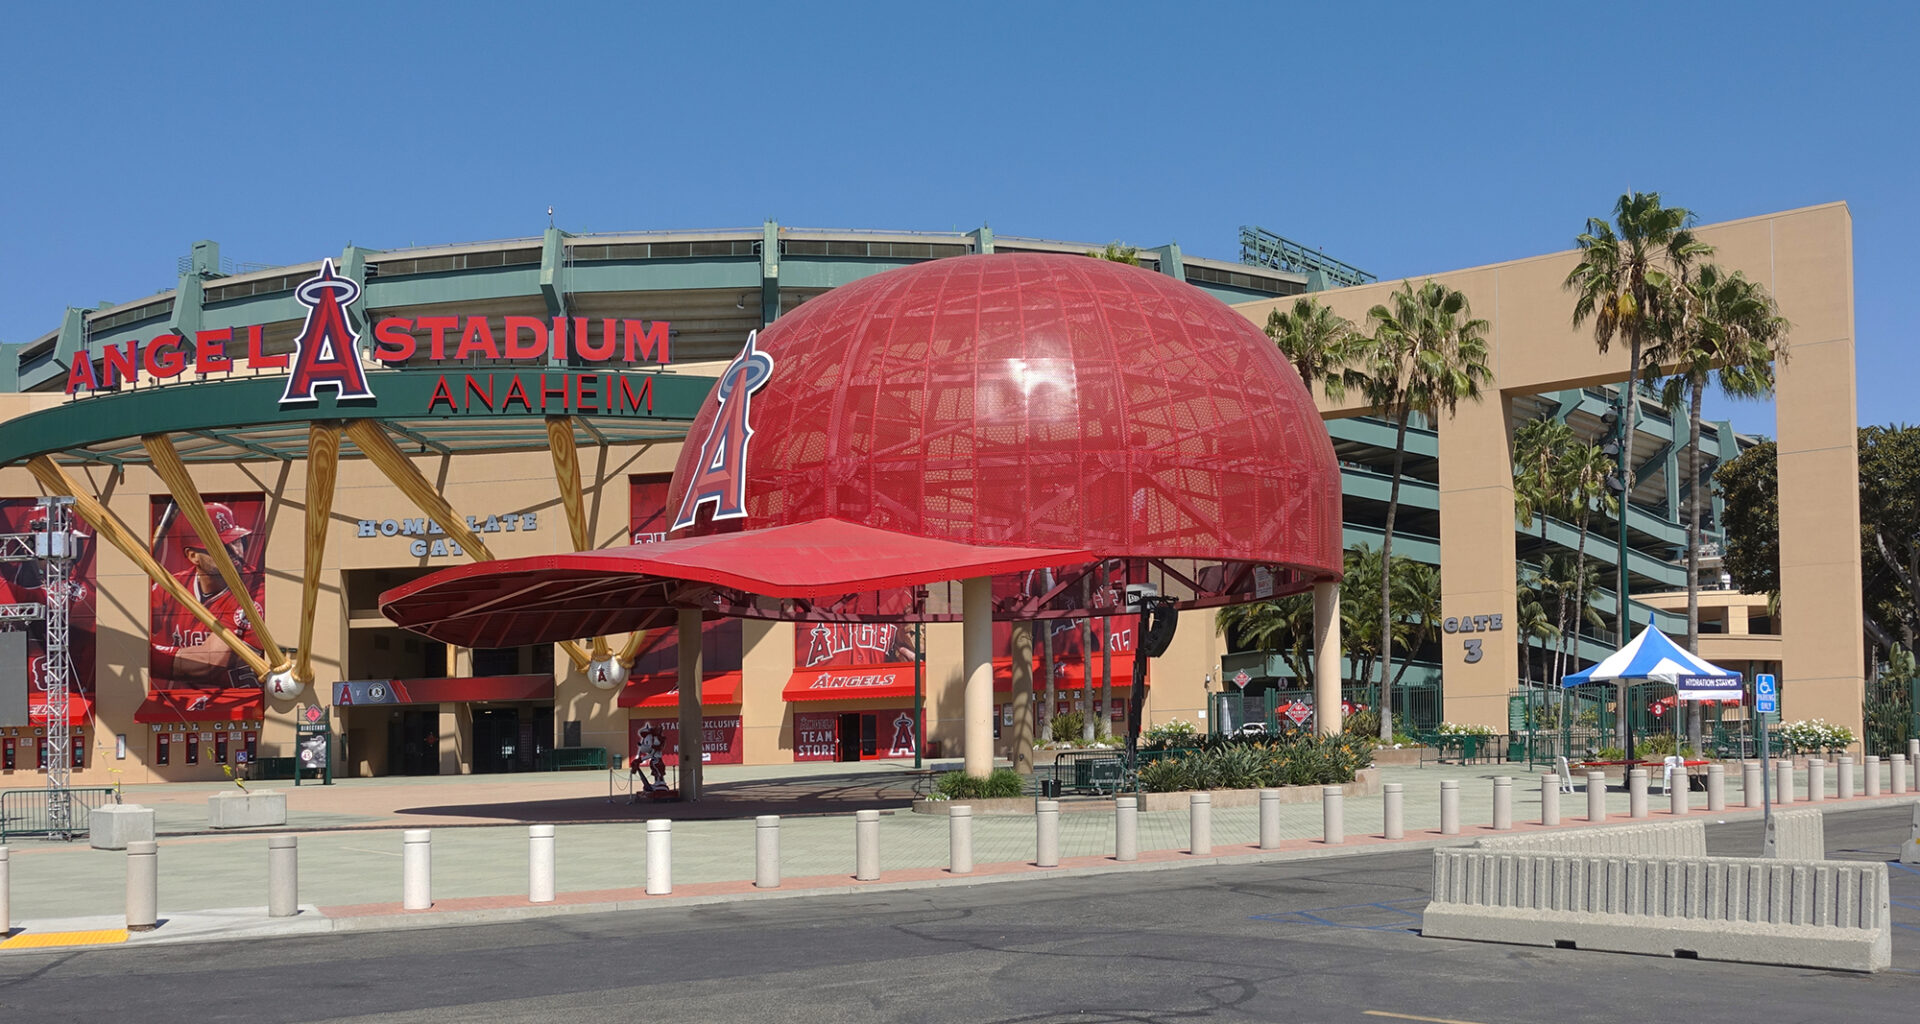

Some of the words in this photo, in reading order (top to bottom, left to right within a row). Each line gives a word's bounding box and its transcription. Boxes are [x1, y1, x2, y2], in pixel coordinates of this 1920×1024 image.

[65, 325, 290, 394] ANGEL
[278, 257, 376, 403] A
[374, 315, 671, 363] STADIUM
[427, 373, 653, 411] ANAHEIM
[670, 329, 775, 532] A
[358, 518, 446, 537] HOME
[466, 513, 537, 533] LATE
[410, 535, 484, 557] GAT
[1443, 614, 1503, 633] GATE
[1463, 639, 1483, 664] 3
[809, 673, 896, 689] ANGELS
[1685, 678, 1714, 687] HYDRATION
[1655, 705, 1662, 715] 3
[152, 723, 199, 732] WILL
[214, 721, 261, 730] CALL
[702, 720, 740, 728] XCLUSIVE
[801, 731, 833, 743] TEAM
[888, 712, 916, 756] A
[798, 744, 836, 756] STORE
